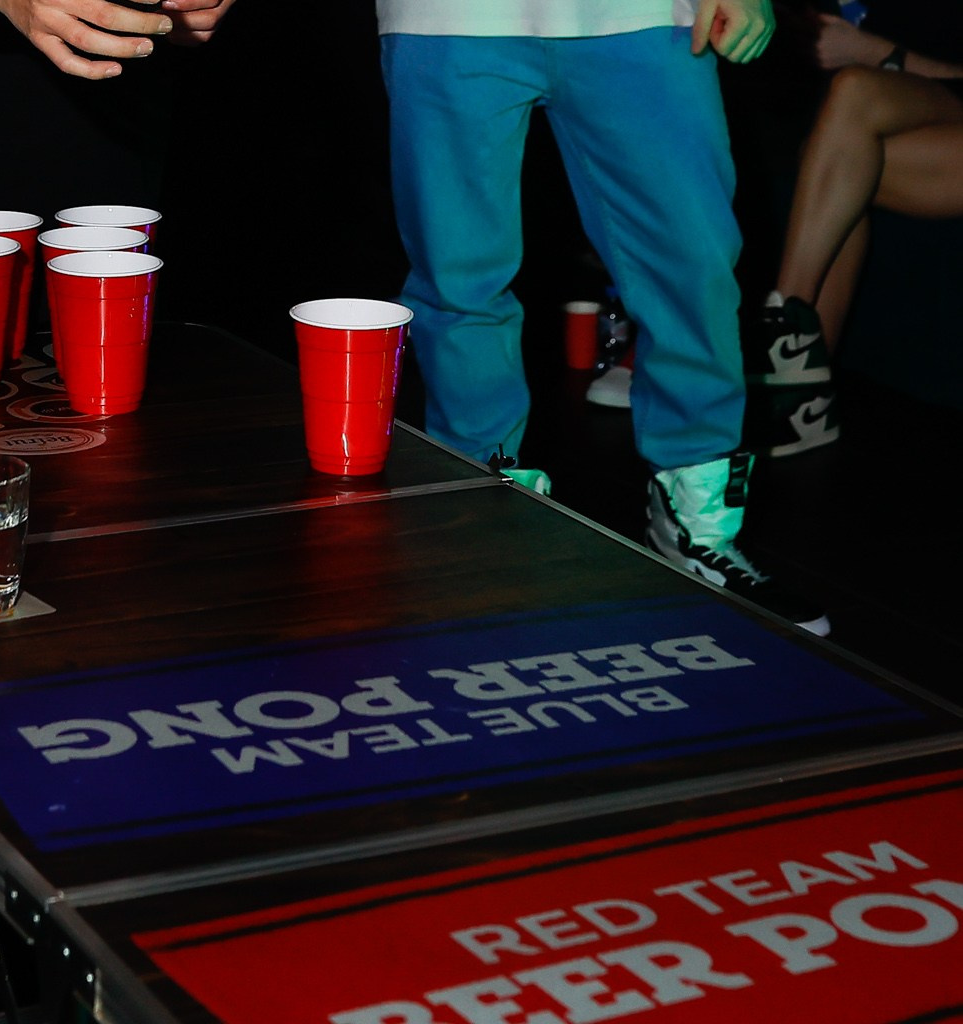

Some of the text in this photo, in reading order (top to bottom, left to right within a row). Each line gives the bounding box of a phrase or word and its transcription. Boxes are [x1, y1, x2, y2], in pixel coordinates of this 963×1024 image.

[4, 435, 74, 447] Beirut
[17, 635, 755, 764] BEER PONG
[212, 687, 689, 774] BLUE TEAM
[453, 841, 927, 963] RED TEAM
